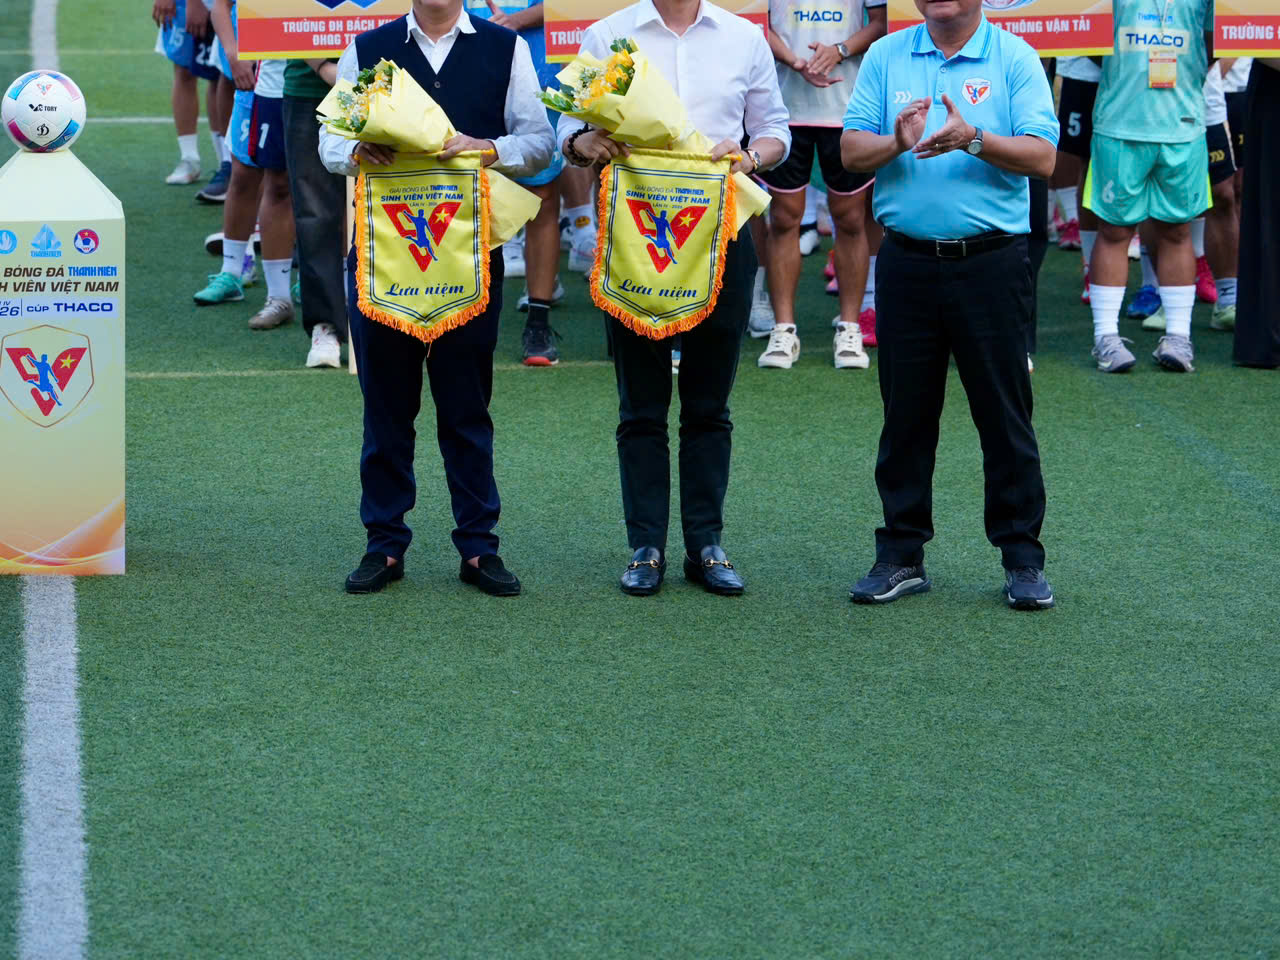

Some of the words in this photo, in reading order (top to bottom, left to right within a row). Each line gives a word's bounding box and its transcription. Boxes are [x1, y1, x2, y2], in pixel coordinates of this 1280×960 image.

[794, 10, 843, 22] THACO
[282, 18, 326, 33] TRƯỜNG
[328, 21, 343, 32] ĐH
[346, 17, 375, 32] BÁCH
[1005, 19, 1043, 34] THÔNG
[1045, 17, 1069, 35] VẬN
[1072, 15, 1091, 31] TẢI
[1221, 21, 1275, 40] TRƯỜNG
[312, 33, 342, 46] ĐHQG
[550, 27, 584, 45] TRƯỜ
[1126, 33, 1184, 48] THACO
[1067, 112, 1082, 137] 5
[381, 194, 402, 202] SINH
[403, 193, 424, 201] VIÊN
[426, 192, 443, 200] VIỆT
[626, 190, 645, 199] SINH
[647, 193, 668, 201] VIÊN
[669, 194, 689, 203] VIỆT
[690, 197, 711, 205] NAM
[3, 264, 42, 278] BÓNG
[46, 264, 65, 278] ĐÁ
[68, 266, 96, 277] THANH
[97, 265, 118, 277] NIÊN
[13, 279, 46, 293] VIÊN
[51, 279, 81, 295] VIỆT
[84, 281, 120, 292] NAM
[385, 282, 420, 297] Lưu
[424, 283, 464, 298] niệm
[618, 279, 653, 296] Lưu
[658, 286, 698, 300] niệm
[26, 303, 50, 313] CÚP
[53, 302, 113, 313] THACO
